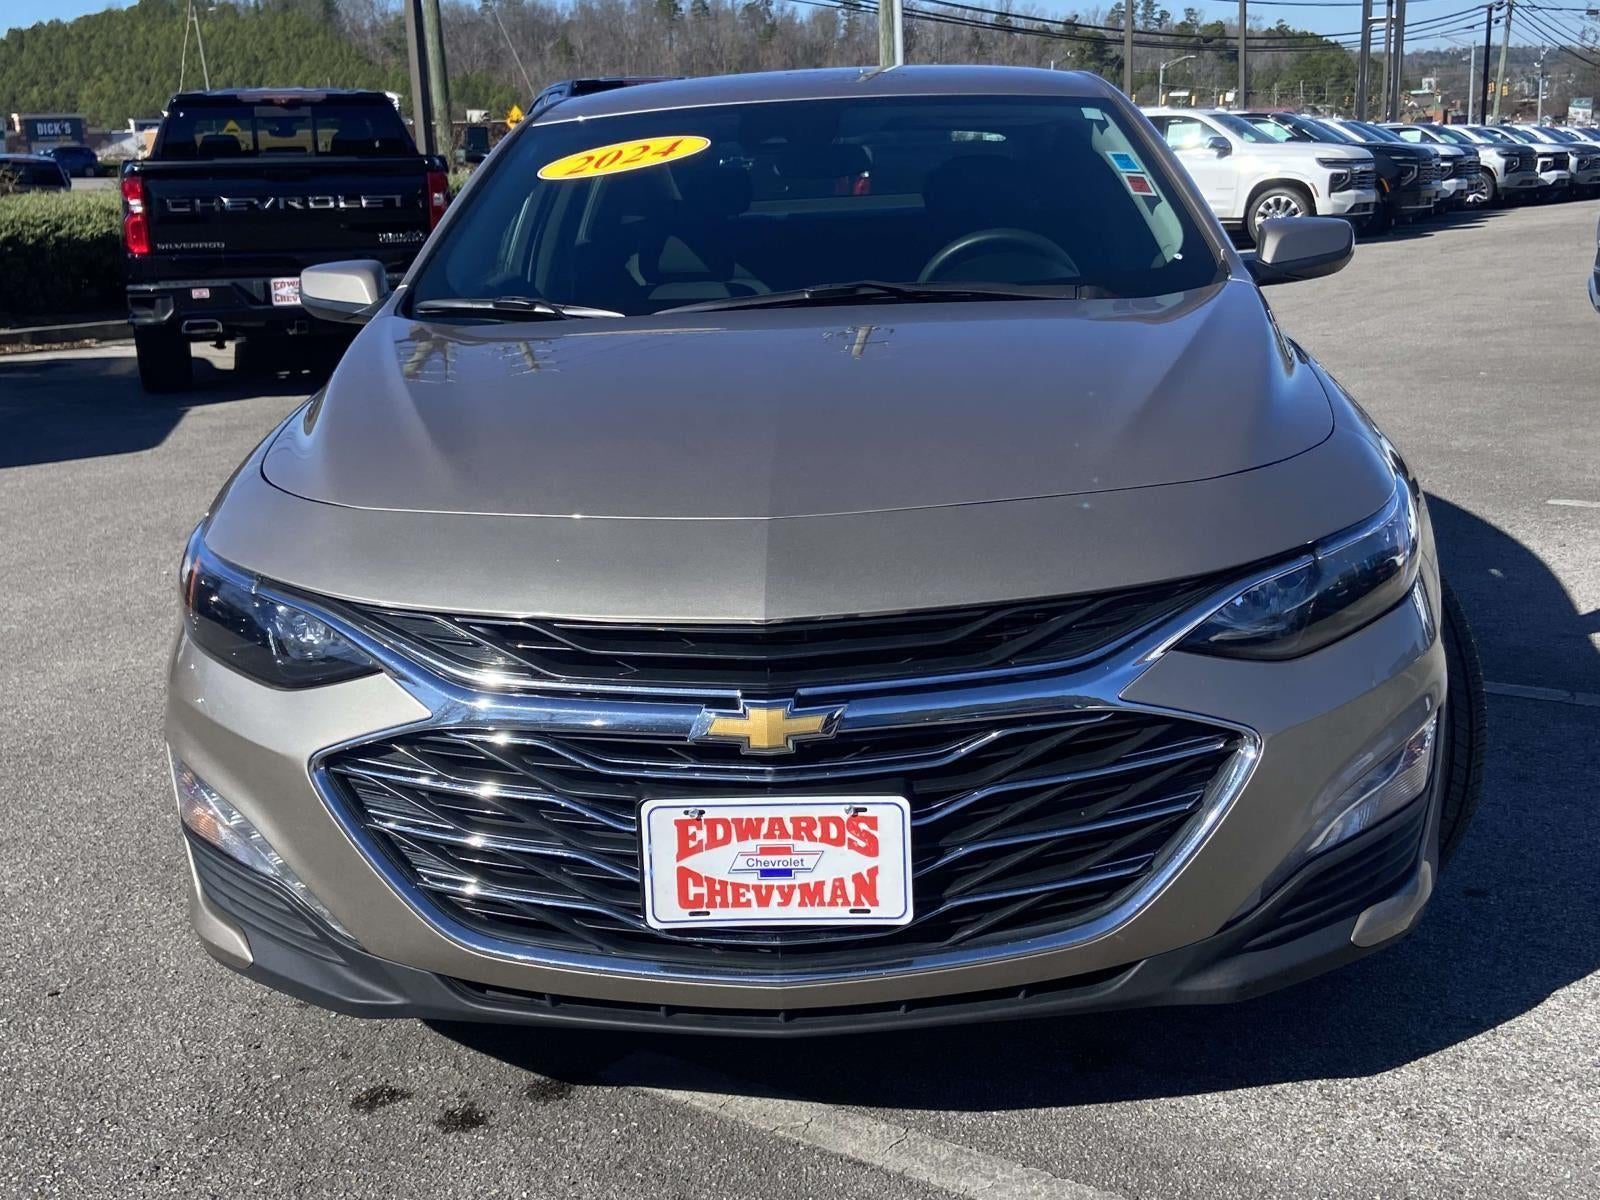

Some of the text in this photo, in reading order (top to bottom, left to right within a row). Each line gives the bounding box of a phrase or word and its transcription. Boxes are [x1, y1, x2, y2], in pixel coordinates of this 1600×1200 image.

[37, 122, 72, 135] DICK'S
[564, 139, 684, 175] 2024
[166, 195, 402, 212] CHEVROLET
[157, 241, 225, 249] SILVERADO
[275, 292, 299, 303] CHEV
[674, 816, 879, 862] EDWARDS
[746, 855, 805, 868] Chevrolet
[676, 865, 880, 909] CHEVYMAN
